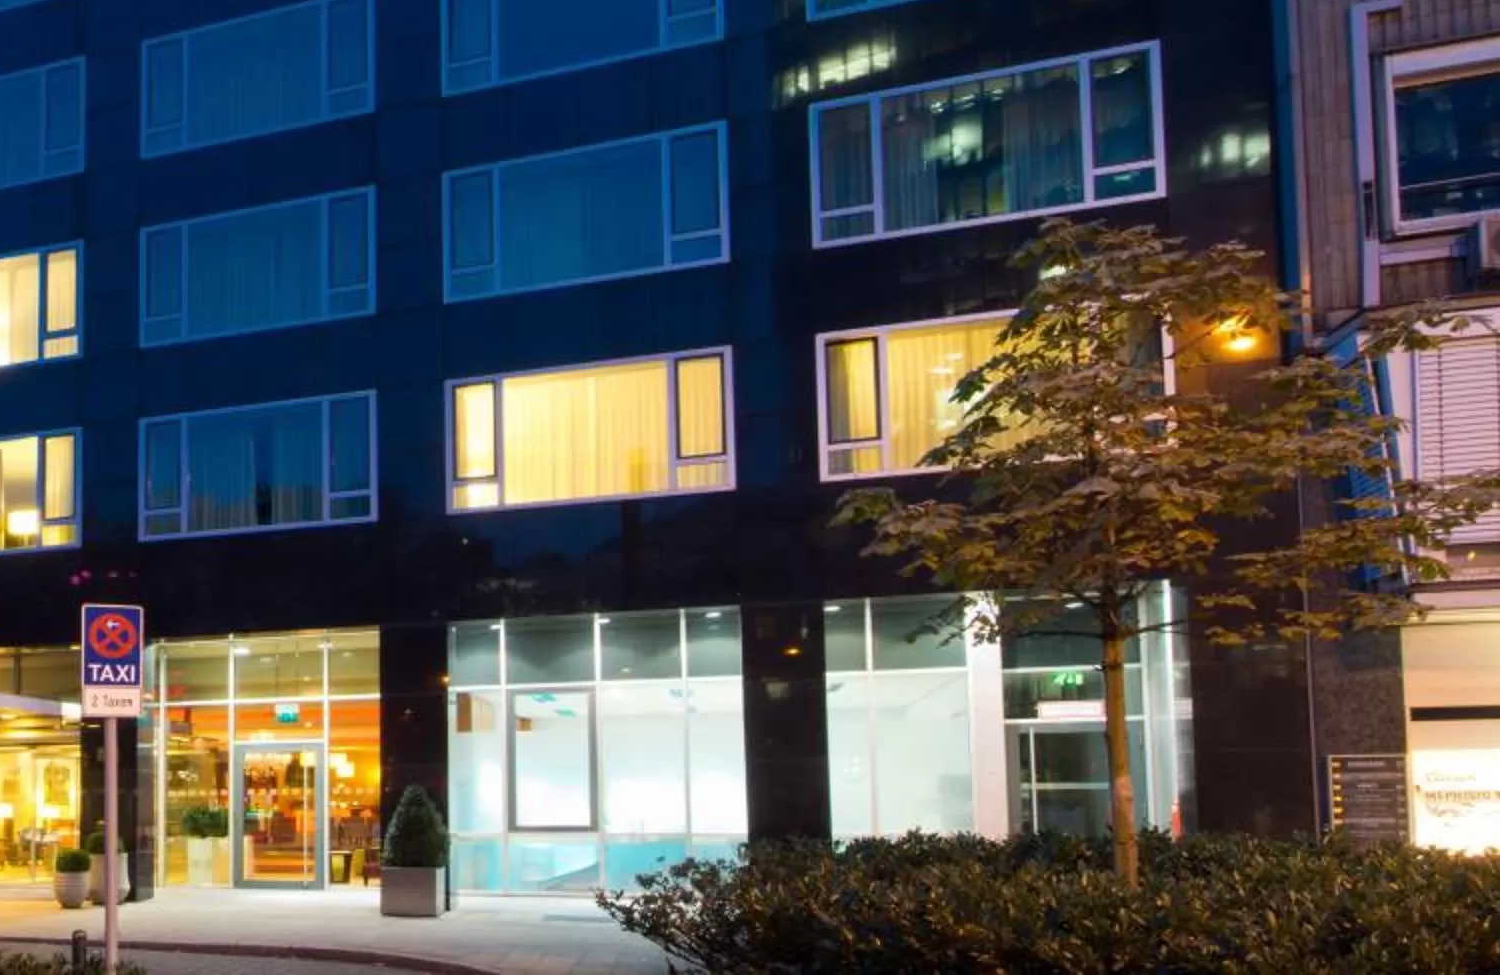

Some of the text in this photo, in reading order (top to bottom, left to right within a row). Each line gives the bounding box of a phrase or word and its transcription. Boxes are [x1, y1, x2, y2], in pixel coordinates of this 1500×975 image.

[87, 664, 135, 683] TAXI
[92, 694, 133, 707] 2 Taxen
